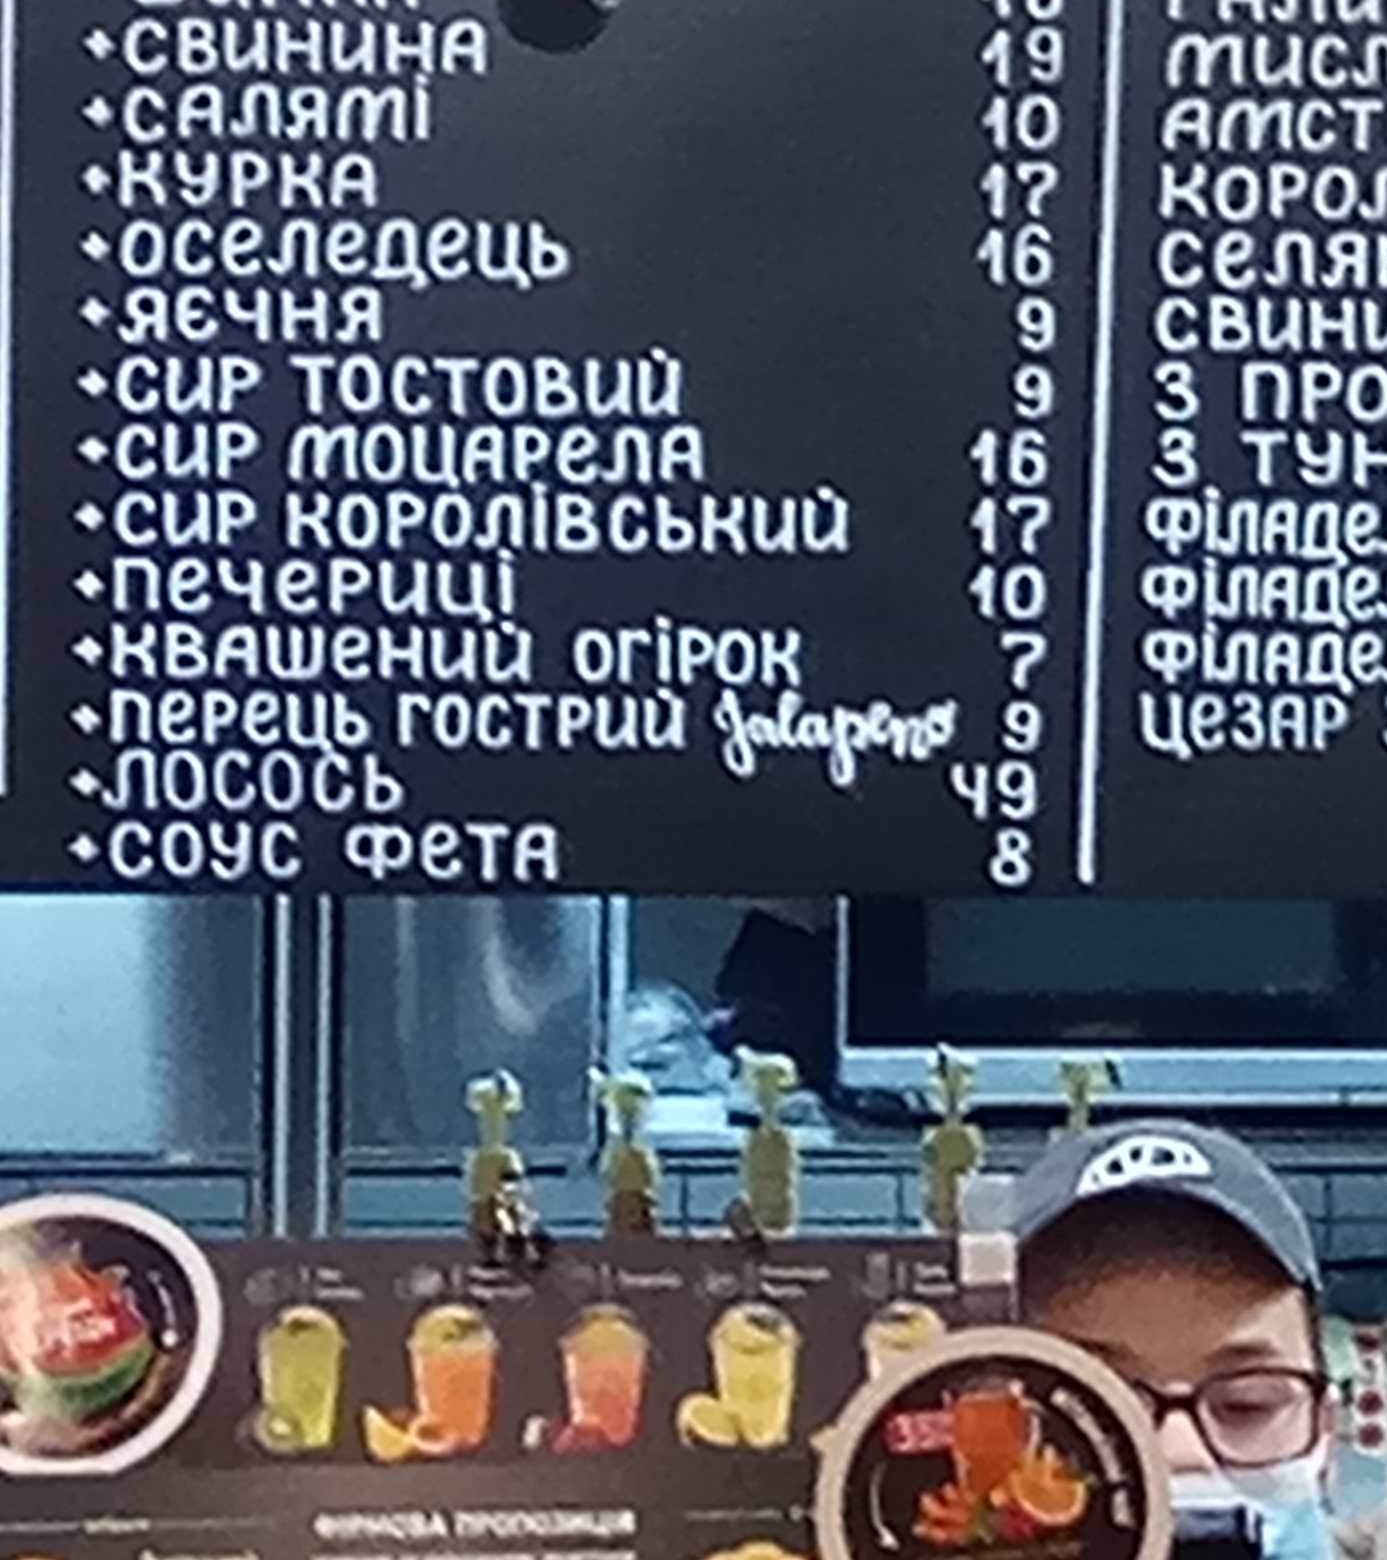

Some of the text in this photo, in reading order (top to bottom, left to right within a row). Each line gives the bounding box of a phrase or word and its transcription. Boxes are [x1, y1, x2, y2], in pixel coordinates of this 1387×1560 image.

[981, 25, 1065, 87] 19
[982, 93, 1061, 151] 10
[980, 160, 1059, 220] 17
[976, 222, 1054, 287] 16
[1016, 296, 1057, 353] 9
[288, 346, 682, 419] ТОСТОВИЙ
[1014, 363, 1055, 420] 9
[1154, 360, 1201, 422] З
[287, 421, 705, 491] МОЦАРЕЛА
[969, 427, 1049, 488] 16
[1151, 426, 1199, 488] З
[285, 479, 849, 555] КОРОЛІВСЬКИЙ
[970, 494, 1052, 555] 17
[969, 564, 1047, 621] 10
[573, 615, 802, 688] ОГІРОК
[1000, 630, 1048, 690] 7
[397, 686, 687, 750] ГОСТРИЙ
[1002, 700, 1043, 753] 9
[1139, 691, 1350, 761] ЦЕЗАР
[950, 759, 1038, 821] 49
[344, 821, 559, 882] ФЕТА
[989, 827, 1032, 887] 8
